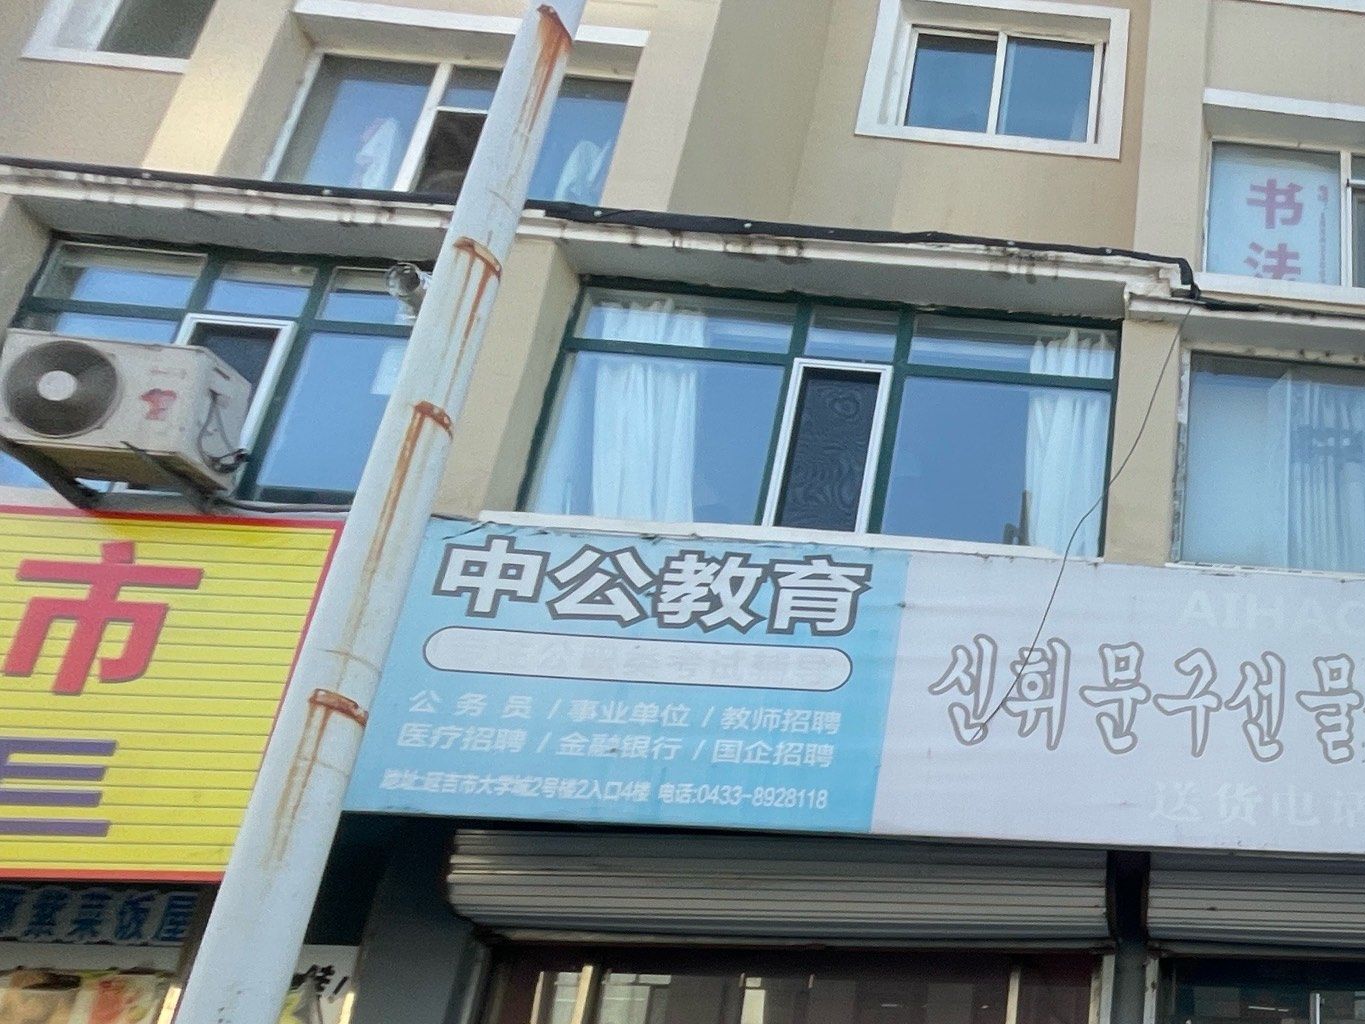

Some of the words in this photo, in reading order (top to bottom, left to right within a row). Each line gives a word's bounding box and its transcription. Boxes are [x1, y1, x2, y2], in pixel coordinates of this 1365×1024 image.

[2, 540, 204, 696] 市
[432, 534, 874, 637] 中公教育
